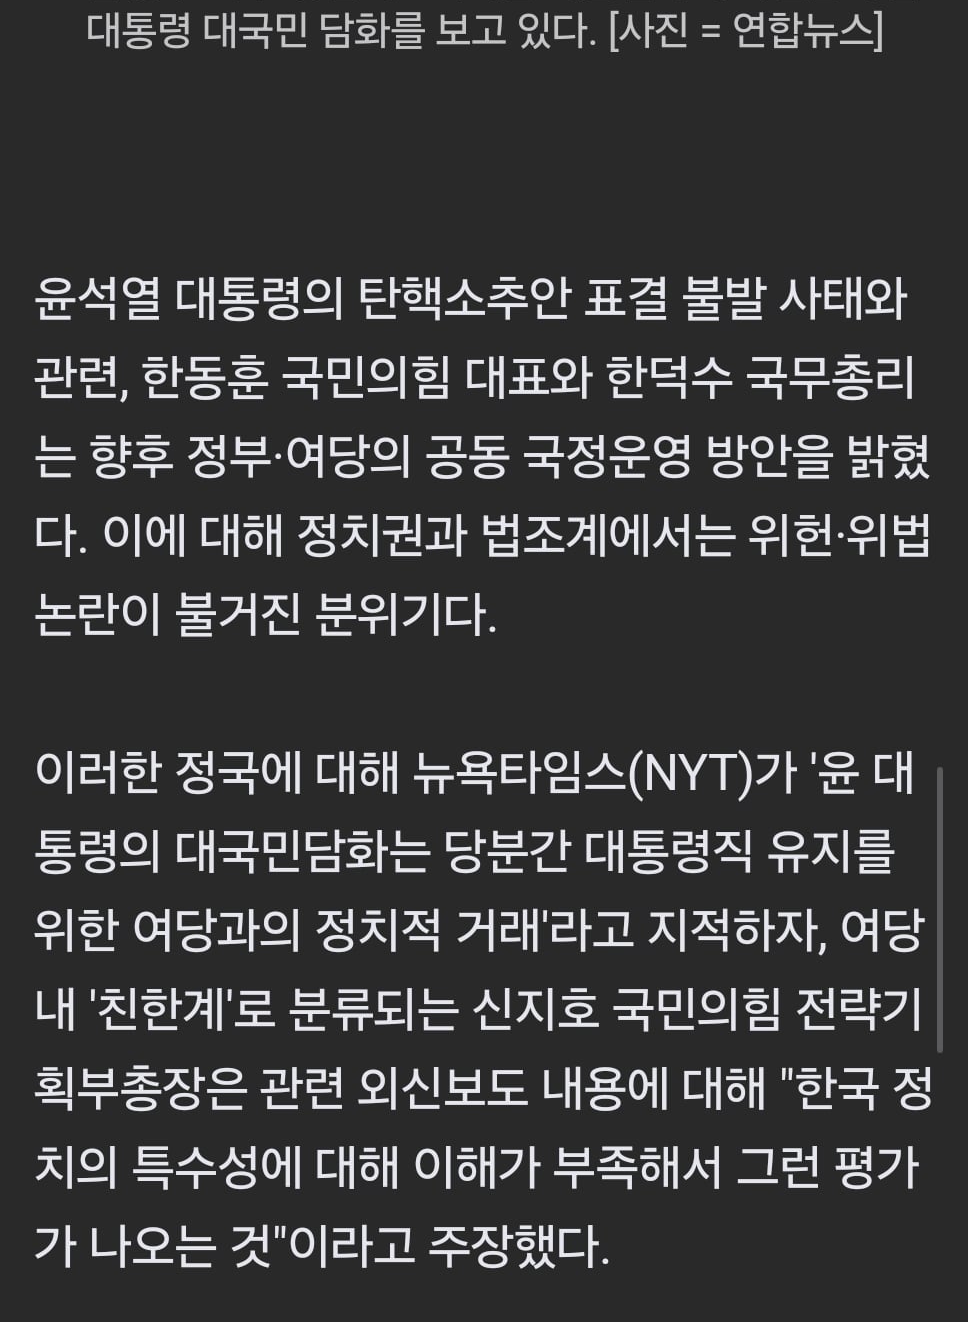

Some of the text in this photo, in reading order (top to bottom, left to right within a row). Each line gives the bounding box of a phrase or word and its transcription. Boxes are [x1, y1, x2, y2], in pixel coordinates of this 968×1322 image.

[88, 11, 882, 52] 대통령 대국민 담화를 보고 있다. [사진 연합뉴스]
[35, 276, 908, 322] 윤석열 대통령의 탄핵소추안 표결 불발 사태와
[34, 354, 912, 403] 관련, 한동훈 국민의힘 대표와 한덕수 국무총리
[35, 435, 76, 478] 는
[90, 435, 173, 479] 향후
[426, 436, 510, 479] 공동
[524, 435, 690, 479] 국정운영
[708, 434, 833, 479] 방안을
[849, 435, 930, 480] 밝혔
[36, 514, 86, 557] 다.
[104, 514, 184, 557] 이에
[201, 514, 281, 557] 대해
[298, 514, 468, 557] 정치권과
[483, 514, 736, 557] 법조계에서는
[35, 592, 496, 637] 논란이 불거진 분위기다.
[37, 750, 162, 794] 이러한
[176, 751, 300, 795] 정국에
[317, 751, 397, 794] 대해
[414, 750, 797, 802] 뉴욕타임스(NYT)가
[875, 751, 912, 794] 대
[35, 829, 895, 875] 통령의 대국민담화는 당분간 대통령직 유지를
[35, 1146, 919, 1190] 치의 특수성에 대해 이해가 부족해서 그런 평가
[35, 1225, 77, 1268] 가
[92, 1224, 216, 1268] 나오는
[429, 1225, 609, 1269] 주장했다.
